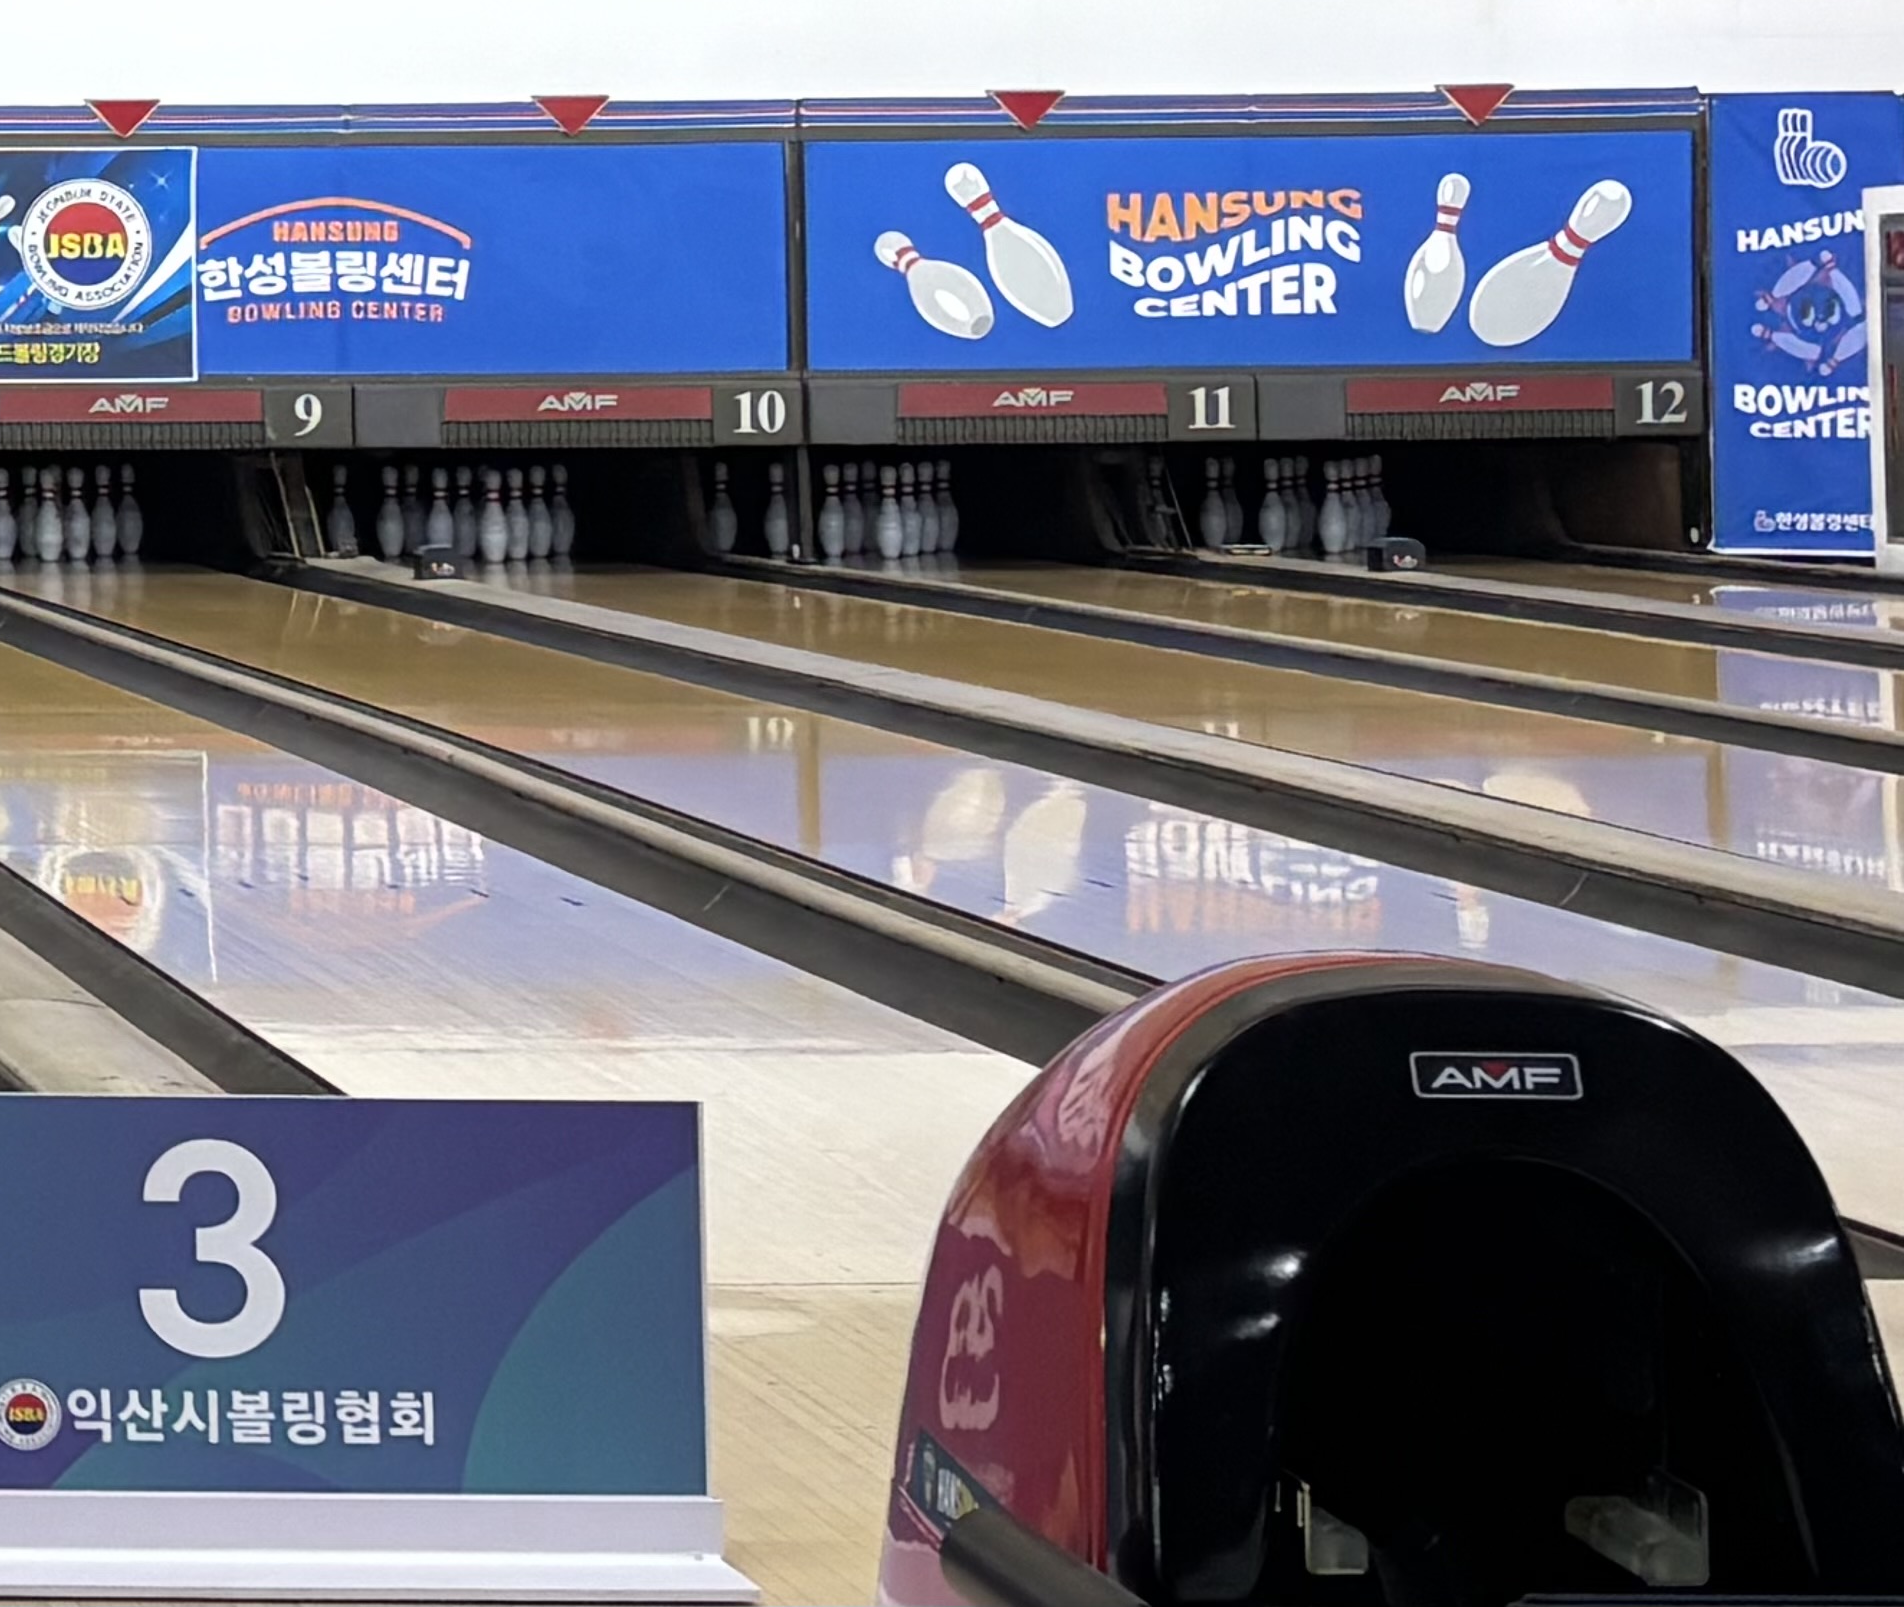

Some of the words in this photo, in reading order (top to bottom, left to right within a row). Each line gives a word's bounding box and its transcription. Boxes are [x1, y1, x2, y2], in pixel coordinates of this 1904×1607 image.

[273, 220, 400, 242] HANSUNG
[1106, 189, 1363, 242] HANSUNG
[1737, 209, 1865, 253] HANSUN
[46, 232, 126, 261] JSBA
[1109, 215, 1361, 292] BOWLING
[197, 250, 471, 302] 한성볼링센터
[1133, 262, 1337, 317] CENTER
[227, 301, 342, 324] BOWLING
[351, 300, 444, 323] CENTER
[88, 393, 169, 414] AMF
[538, 391, 618, 412] AMF
[734, 390, 786, 433] 10
[992, 387, 1074, 407] AMF
[1188, 386, 1235, 429] 11
[1439, 382, 1520, 403] AMF
[1636, 381, 1687, 424] 12
[1734, 383, 1871, 417] BOWLIN
[294, 393, 322, 436] 9
[1430, 1066, 1563, 1091] AMF
[138, 1137, 287, 1359] 3
[66, 1388, 436, 1447] 익산시볼링협회
